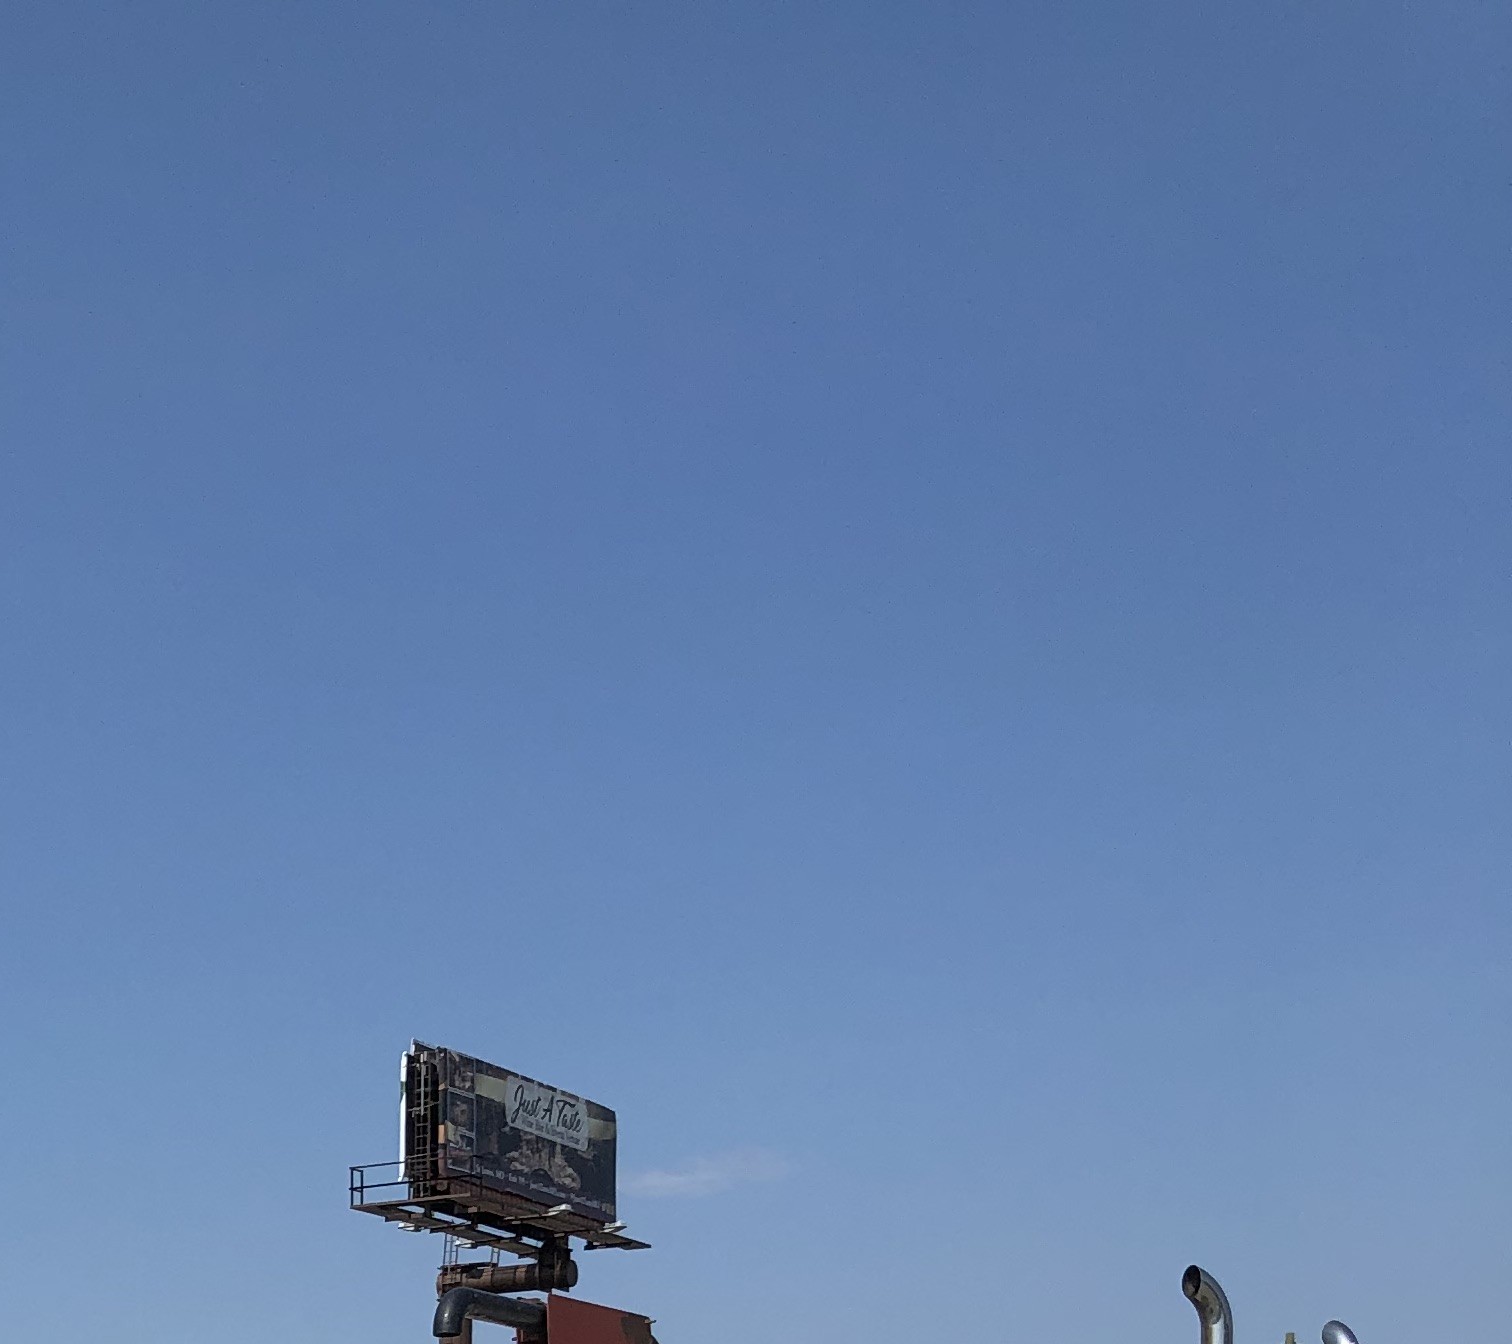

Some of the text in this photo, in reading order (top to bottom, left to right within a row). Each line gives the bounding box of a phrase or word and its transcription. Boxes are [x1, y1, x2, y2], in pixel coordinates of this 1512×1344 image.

[511, 1084, 542, 1123] Just
[541, 1095, 555, 1122] A
[556, 1099, 584, 1133] Taste
